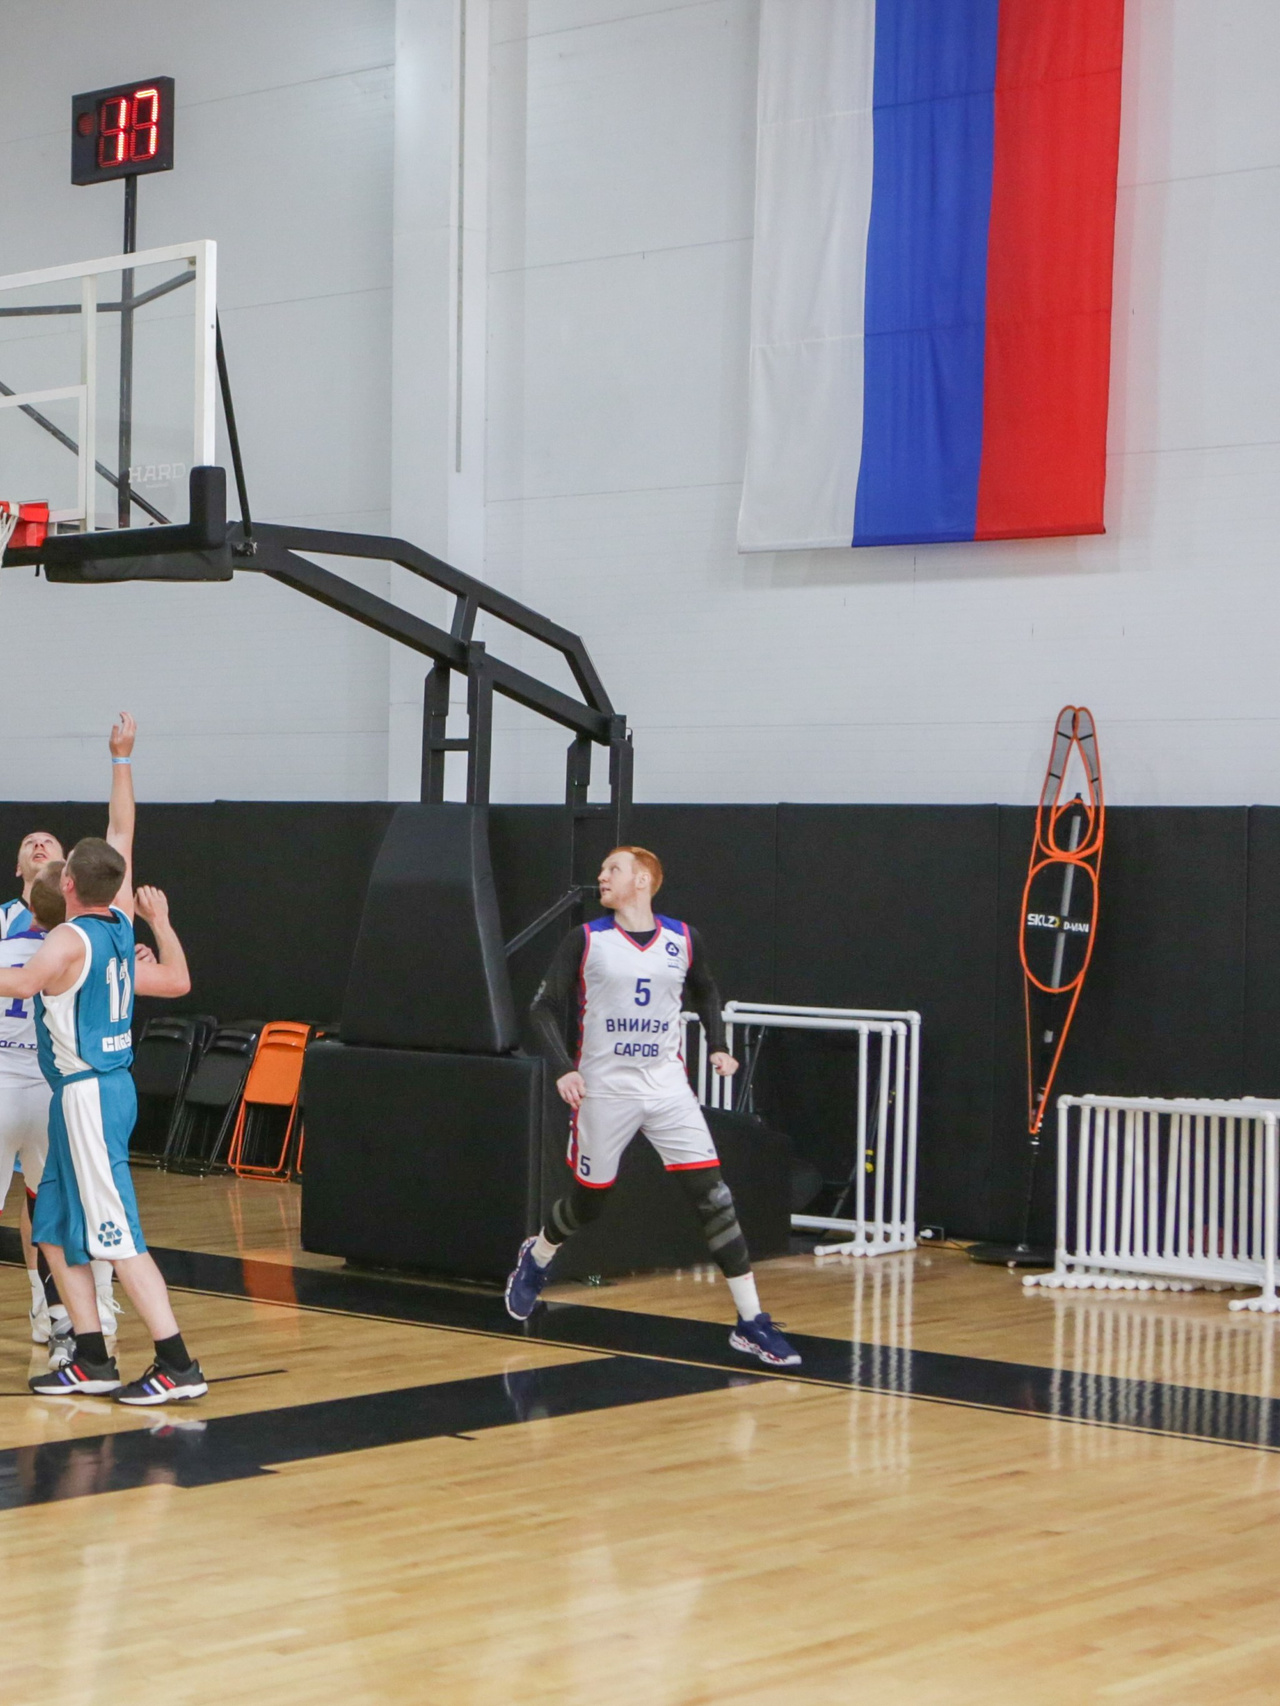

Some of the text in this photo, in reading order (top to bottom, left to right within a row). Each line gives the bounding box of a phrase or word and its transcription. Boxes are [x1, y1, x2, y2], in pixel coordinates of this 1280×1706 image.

[116, 88, 158, 161] 17
[128, 462, 186, 483] HARD
[1027, 913, 1089, 933] SKLZ D-MAN
[634, 978, 651, 1007] 5
[614, 1042, 659, 1057] САРОВ
[580, 1155, 591, 1177] 5
